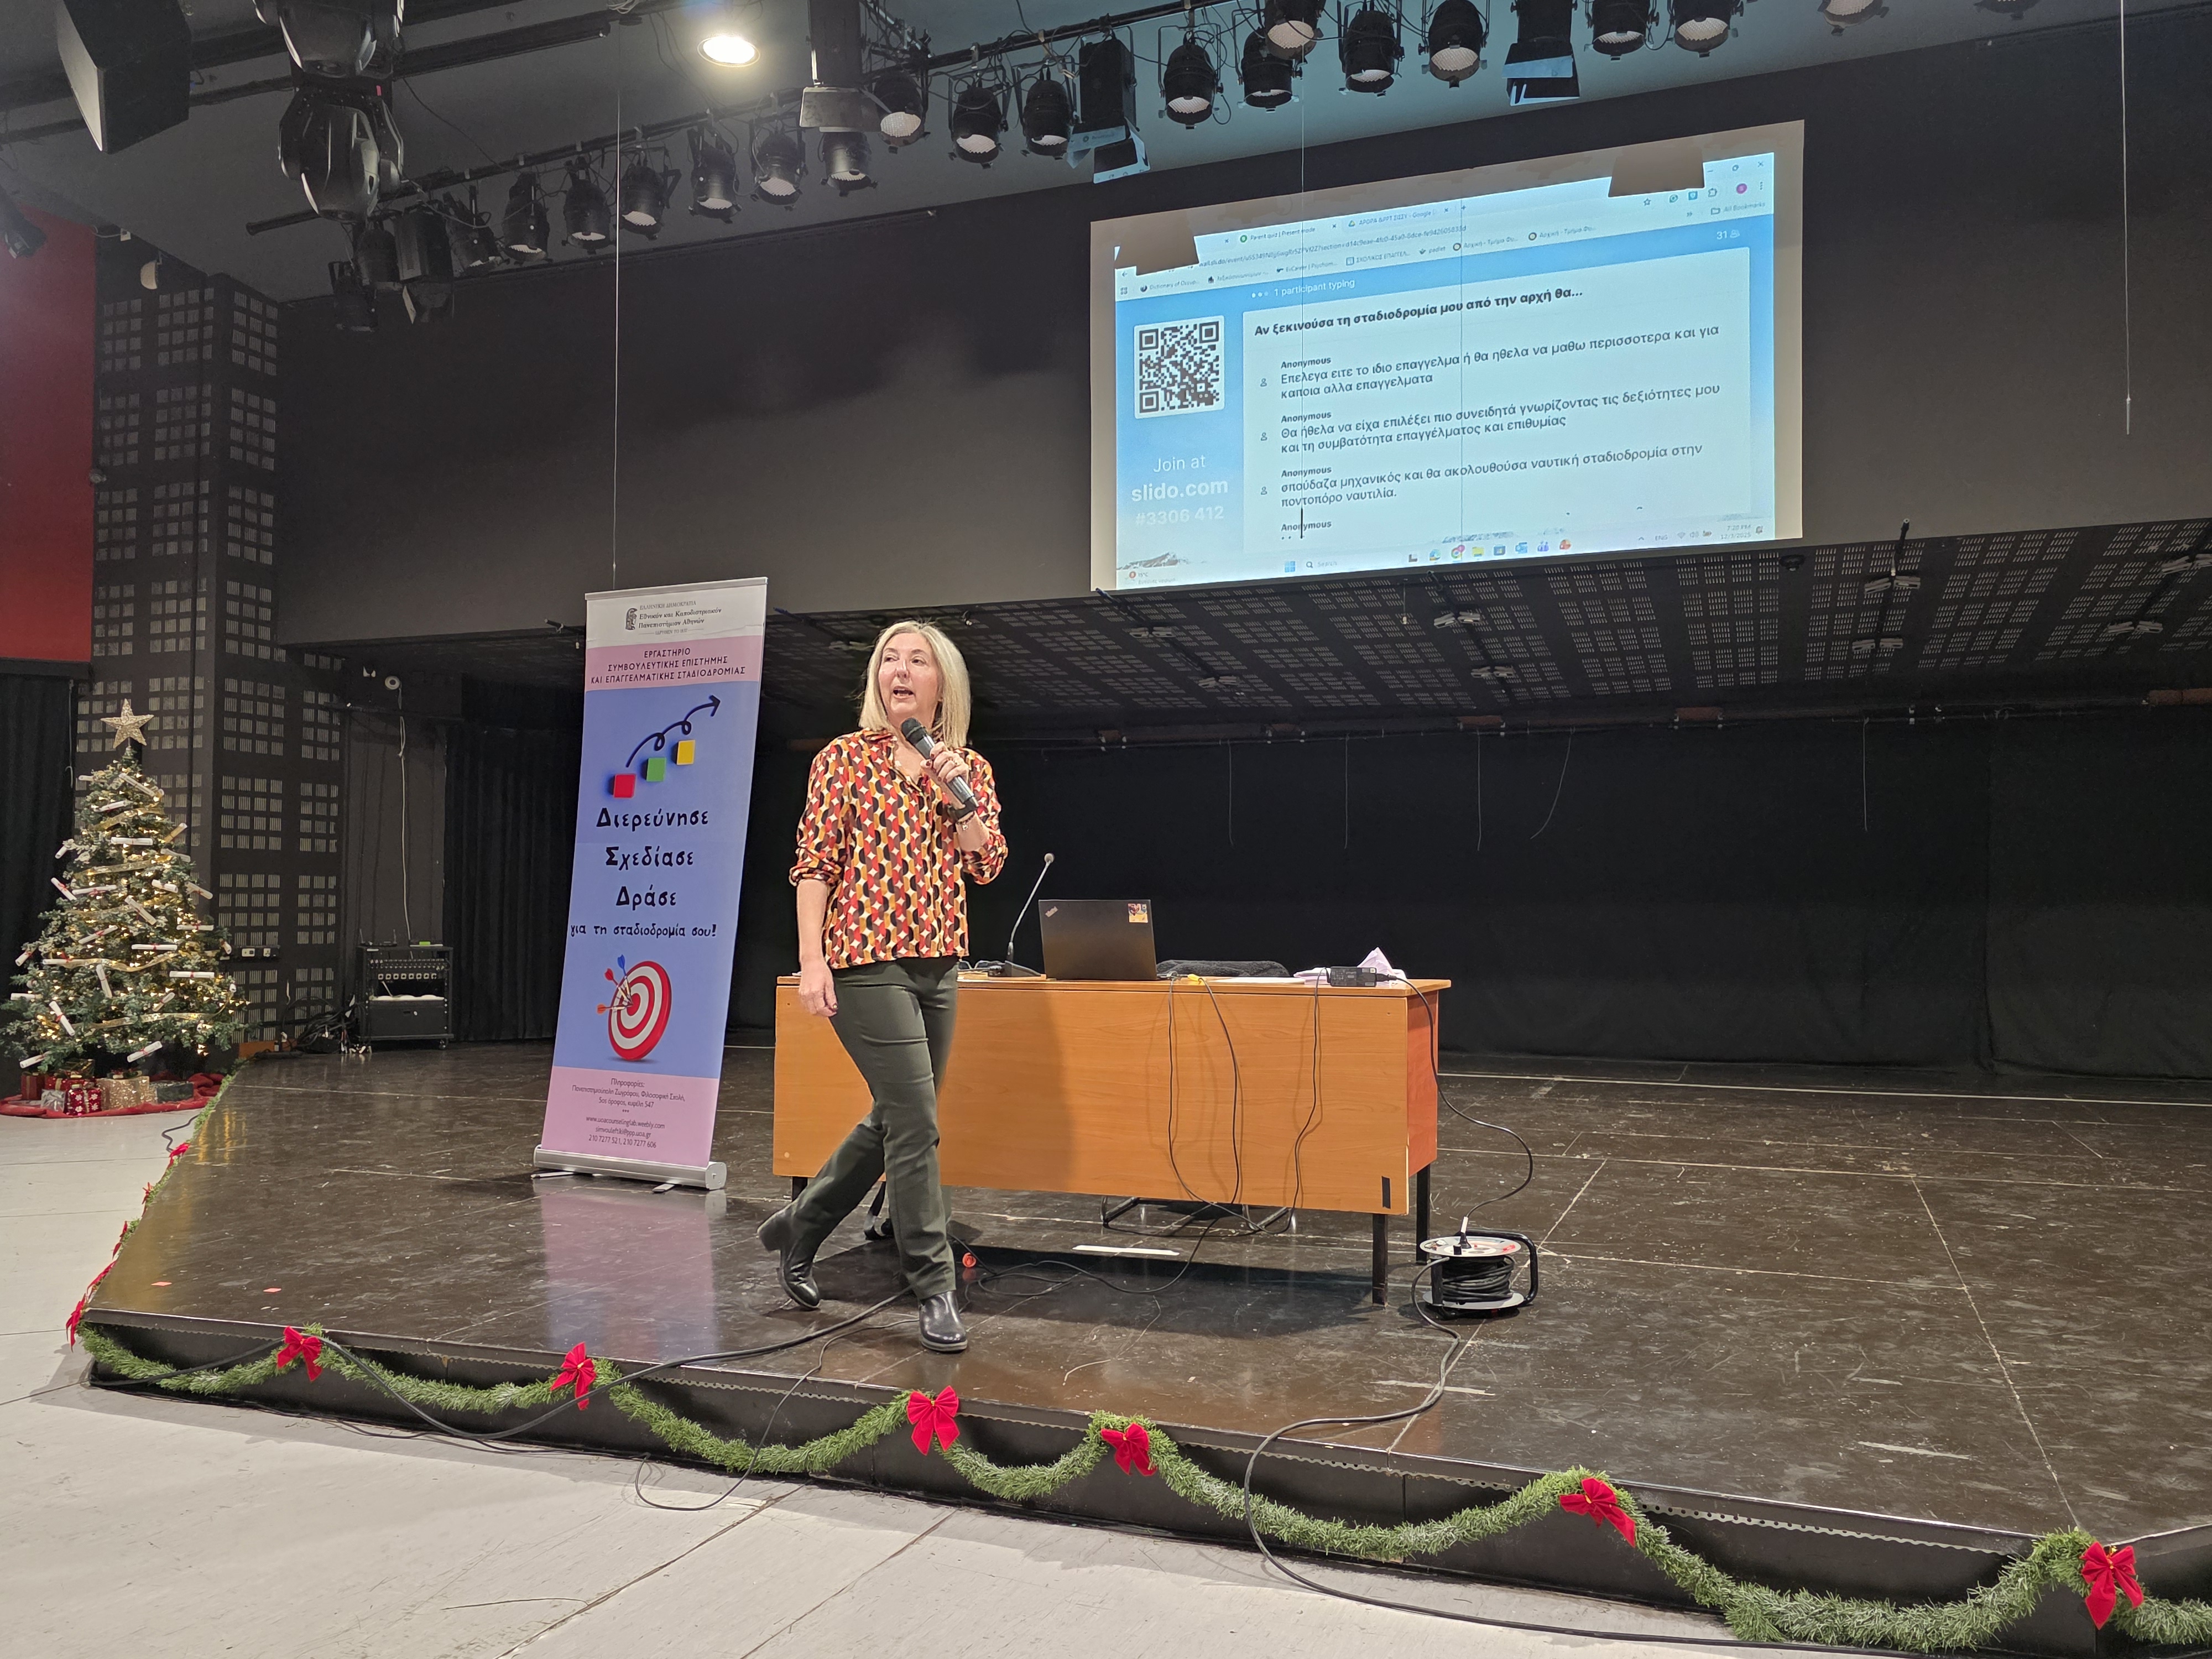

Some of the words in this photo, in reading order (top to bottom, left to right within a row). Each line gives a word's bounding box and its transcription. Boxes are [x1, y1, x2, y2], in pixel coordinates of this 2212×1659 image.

[1717, 231, 1727, 240] 31
[1281, 283, 1326, 298] participant
[1328, 279, 1355, 291] typing
[1255, 326, 1270, 336] Αν
[1273, 319, 1333, 335] ξεκινούσα
[1338, 317, 1350, 327] τη
[1354, 304, 1437, 324] σταδιοδρομία
[1441, 303, 1463, 315] μου
[1467, 297, 1491, 309] από
[1495, 296, 1516, 307] την
[1520, 289, 1551, 304] αρχή
[1554, 288, 1583, 299] θα...
[1281, 371, 1328, 385] Επελεγα
[1332, 369, 1353, 379] ειτε
[1357, 367, 1369, 375] το
[1373, 362, 1392, 374] ιδιο
[1396, 356, 1460, 372] επαγγελμα
[1463, 352, 1471, 365] ή
[1474, 352, 1489, 362] θα
[1493, 347, 1529, 362] ηθελα
[1533, 346, 1548, 356] να
[1552, 341, 1585, 356] μαθω
[1590, 331, 1671, 349] περισσοτερα
[1675, 328, 1695, 339] και
[1699, 326, 1719, 338] για
[1281, 357, 1331, 369] Anonymous
[1281, 387, 1320, 399] καποια
[1324, 382, 1352, 394] αλλα
[1356, 374, 1433, 391] επαγγελματα
[1281, 427, 1297, 439] Θα
[1301, 422, 1334, 438] ήθελα
[1338, 422, 1352, 433] να
[1355, 420, 1380, 432] είχα
[1384, 414, 1431, 427] επιλέξει
[1434, 413, 1452, 422] πιο
[1456, 404, 1516, 420] συνειδητά
[1520, 397, 1598, 414] γνωρίζοντας
[1602, 395, 1619, 406] τις
[1623, 387, 1691, 403] δεξιότητες
[1695, 385, 1720, 398] μου
[1281, 411, 1332, 424] Anonymous
[1281, 444, 1299, 453] και
[1302, 442, 1314, 452] τη
[1318, 434, 1393, 450] συμβατότητα
[1396, 424, 1480, 441] επαγγέλματος
[1484, 423, 1504, 433] και
[1507, 415, 1566, 430] επιθυμίας
[1154, 456, 1185, 473] Join
[1191, 455, 1206, 469] at
[1281, 478, 1337, 492] σπούδαζα
[1340, 471, 1400, 489] μηχανικός
[1404, 471, 1423, 481] και
[1427, 468, 1441, 479] θα
[1444, 460, 1527, 477] ακολουθούσα
[1531, 453, 1579, 469] ναυτική
[1583, 446, 1668, 463] σταδιοδρομία
[1672, 444, 1703, 456] στην
[1281, 467, 1332, 478] Anonymous
[1131, 480, 1228, 502] slido.com
[1281, 493, 1342, 507] ποντοπόρο
[1346, 487, 1397, 501] ναυτιλία.
[1135, 509, 1190, 525] #3306
[1194, 505, 1224, 520] 412
[675, 607, 722, 617] Καποδιστριακόν
[638, 620, 681, 629] Πανεπιστήμιον
[682, 617, 705, 625] Αθηνών
[644, 648, 691, 659] ΕΡΓΑΣΤΗΡΙΟ
[608, 660, 679, 672] ΣΥΜΒΟΥΛΕΥΤΙΚΗΣ
[682, 656, 728, 668] ΕΠΙΣΤΗΜΗΣ
[591, 675, 603, 684] ΚΑΙ
[606, 671, 675, 684] ΕΠΑΓΓΕΛΜΑΤΙΚΗΣ
[677, 666, 746, 680] ΣΤΑΔΙΟΔΡΟΜΙΑΣ
[596, 807, 708, 832] Διερεύνησε
[606, 845, 694, 870] Σχεδίασε
[615, 884, 677, 911] Δράσε
[570, 924, 586, 937] για
[593, 924, 607, 936] τη
[613, 923, 686, 939] σταδιοδρομία
[691, 924, 717, 937] σου!
[611, 1078, 645, 1088] Πληροφορίες:
[586, 1116, 665, 1129] www.uoacounselinglab.weebly.com
[599, 1135, 611, 1144] 7277
[612, 1137, 622, 1145] 521,
[634, 1139, 646, 1147] 7277
